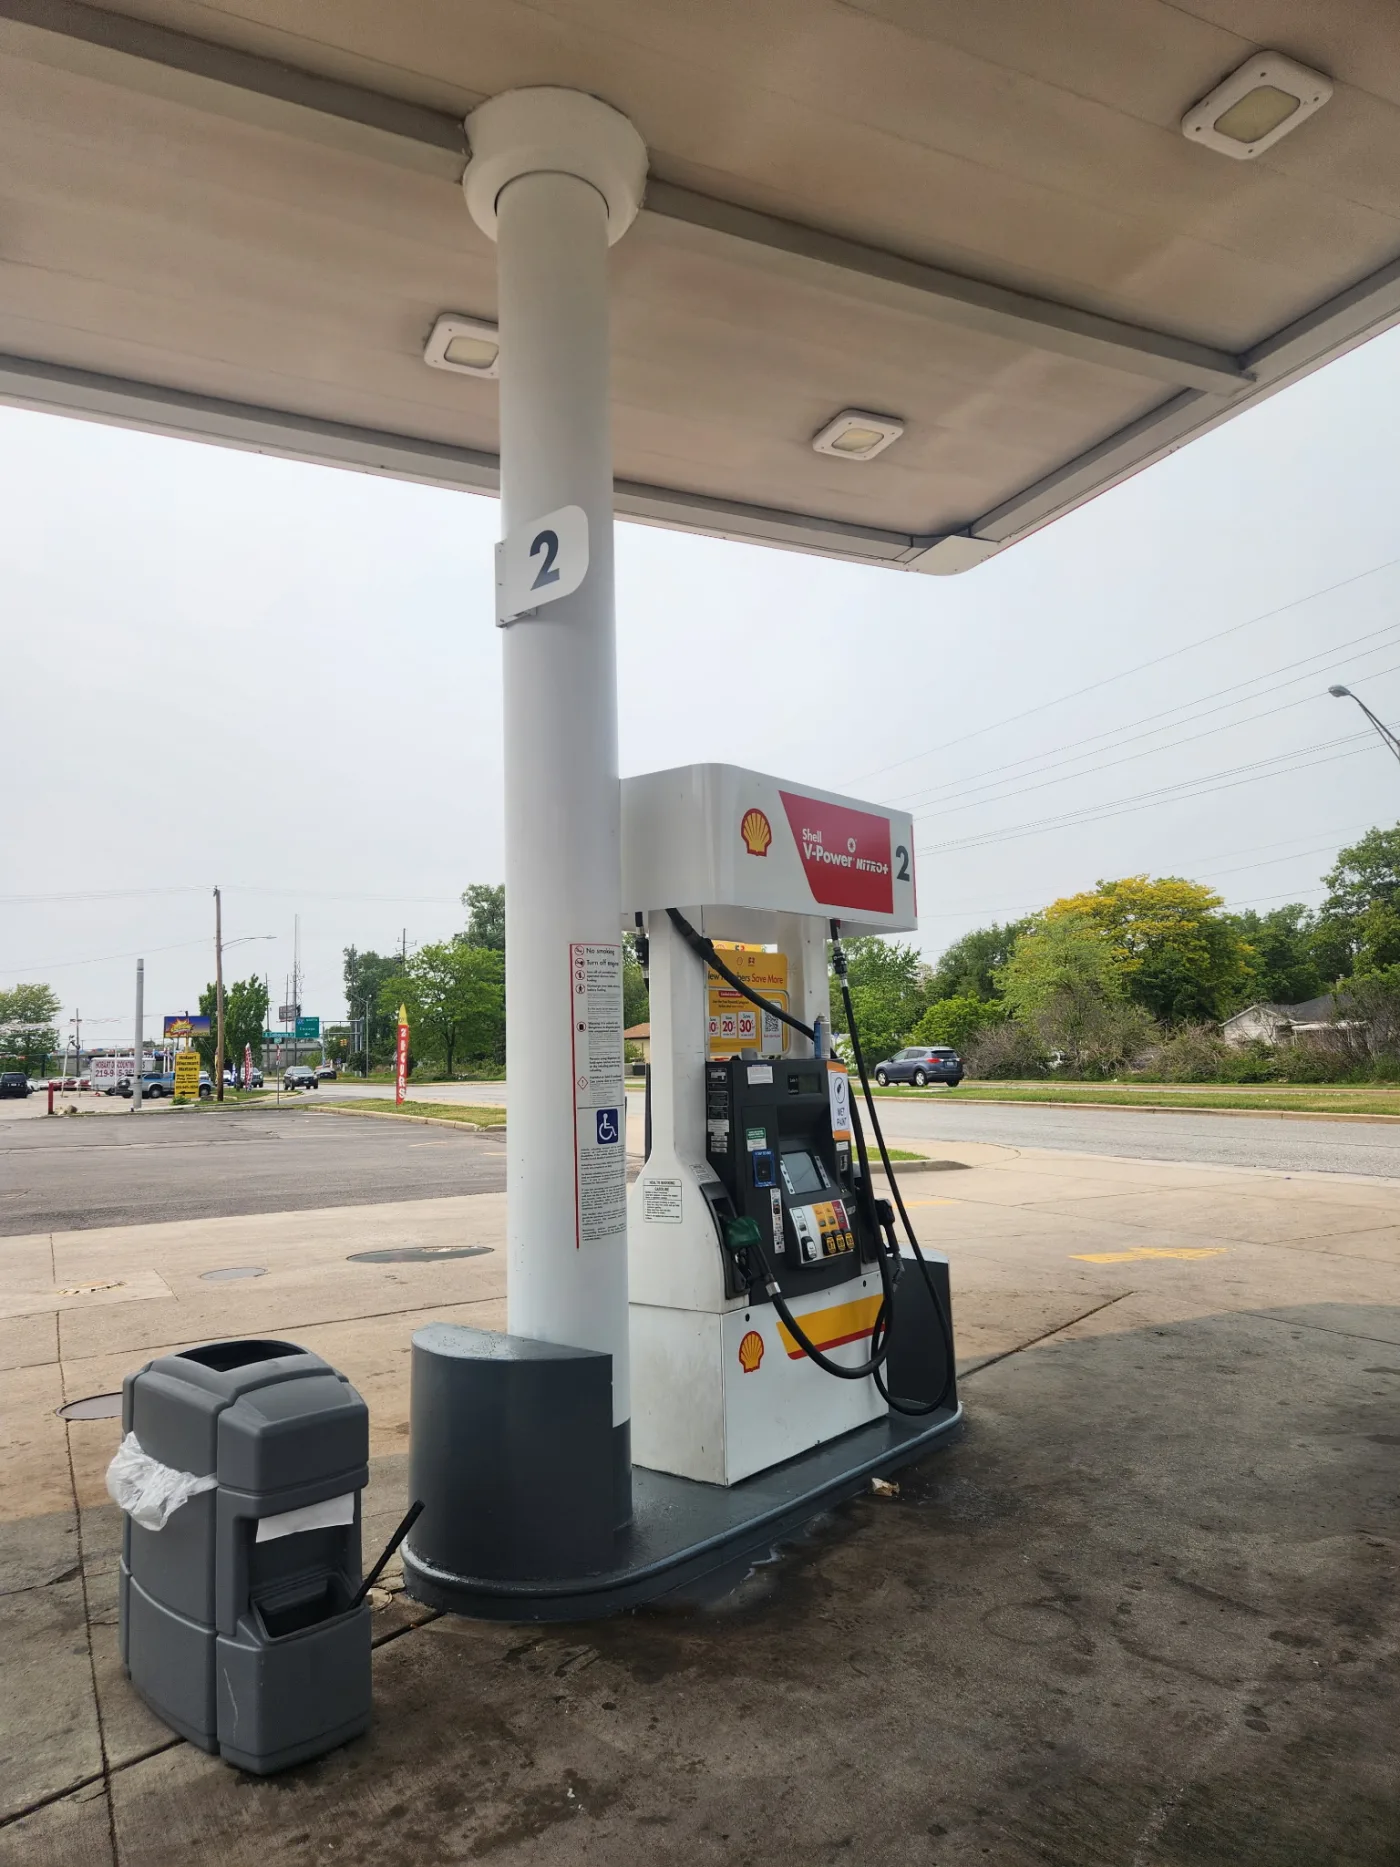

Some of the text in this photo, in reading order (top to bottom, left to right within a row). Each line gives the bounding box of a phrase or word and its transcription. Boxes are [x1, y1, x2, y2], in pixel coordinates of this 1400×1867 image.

[529, 529, 560, 591] 2
[802, 828, 822, 843] Shell
[803, 842, 853, 868] V-Power
[895, 845, 910, 882] 2
[597, 947, 615, 956] smoking
[599, 958, 607, 966] off
[752, 973, 767, 984] Save
[767, 974, 784, 984] More
[95, 1060, 111, 1069] HOBART
[837, 1107, 845, 1116] WET
